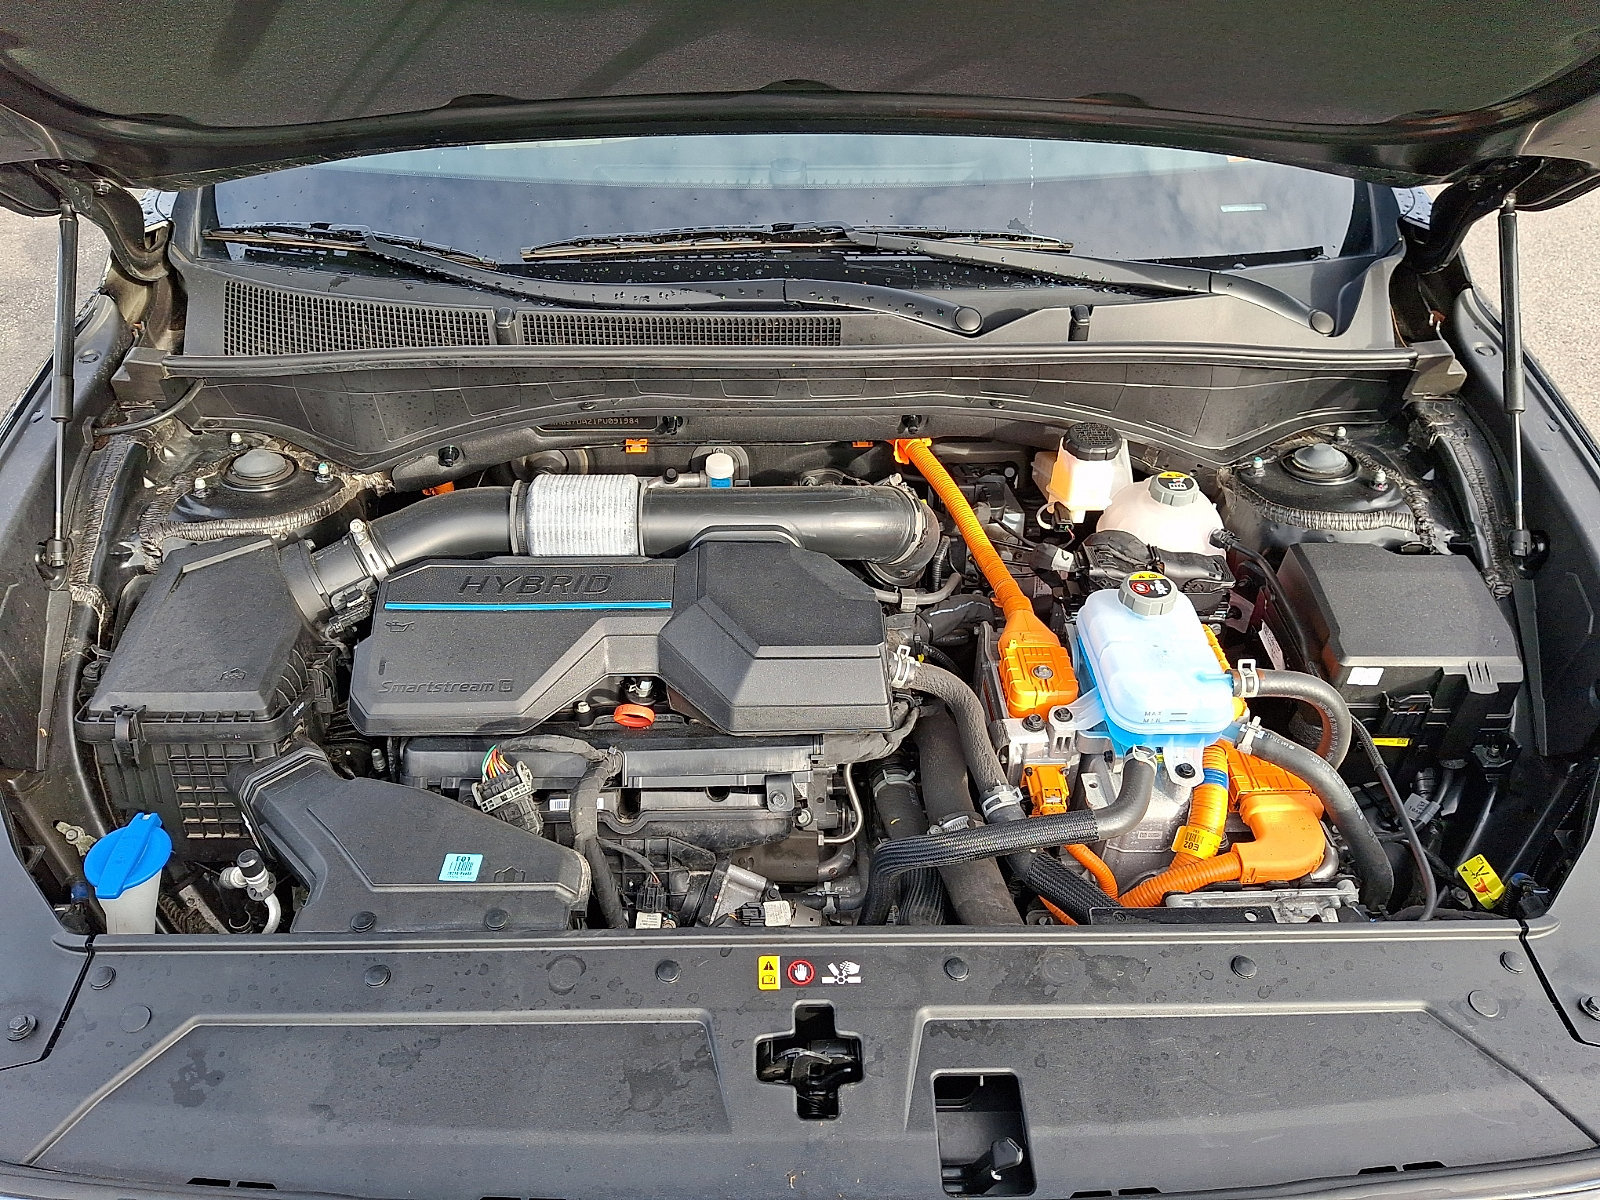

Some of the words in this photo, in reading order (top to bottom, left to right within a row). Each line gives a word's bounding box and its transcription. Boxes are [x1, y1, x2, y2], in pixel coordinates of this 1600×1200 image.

[457, 574, 612, 595] HYBRID
[379, 681, 496, 693] Smartstream
[498, 678, 513, 693] G
[1183, 841, 1199, 851] E02
